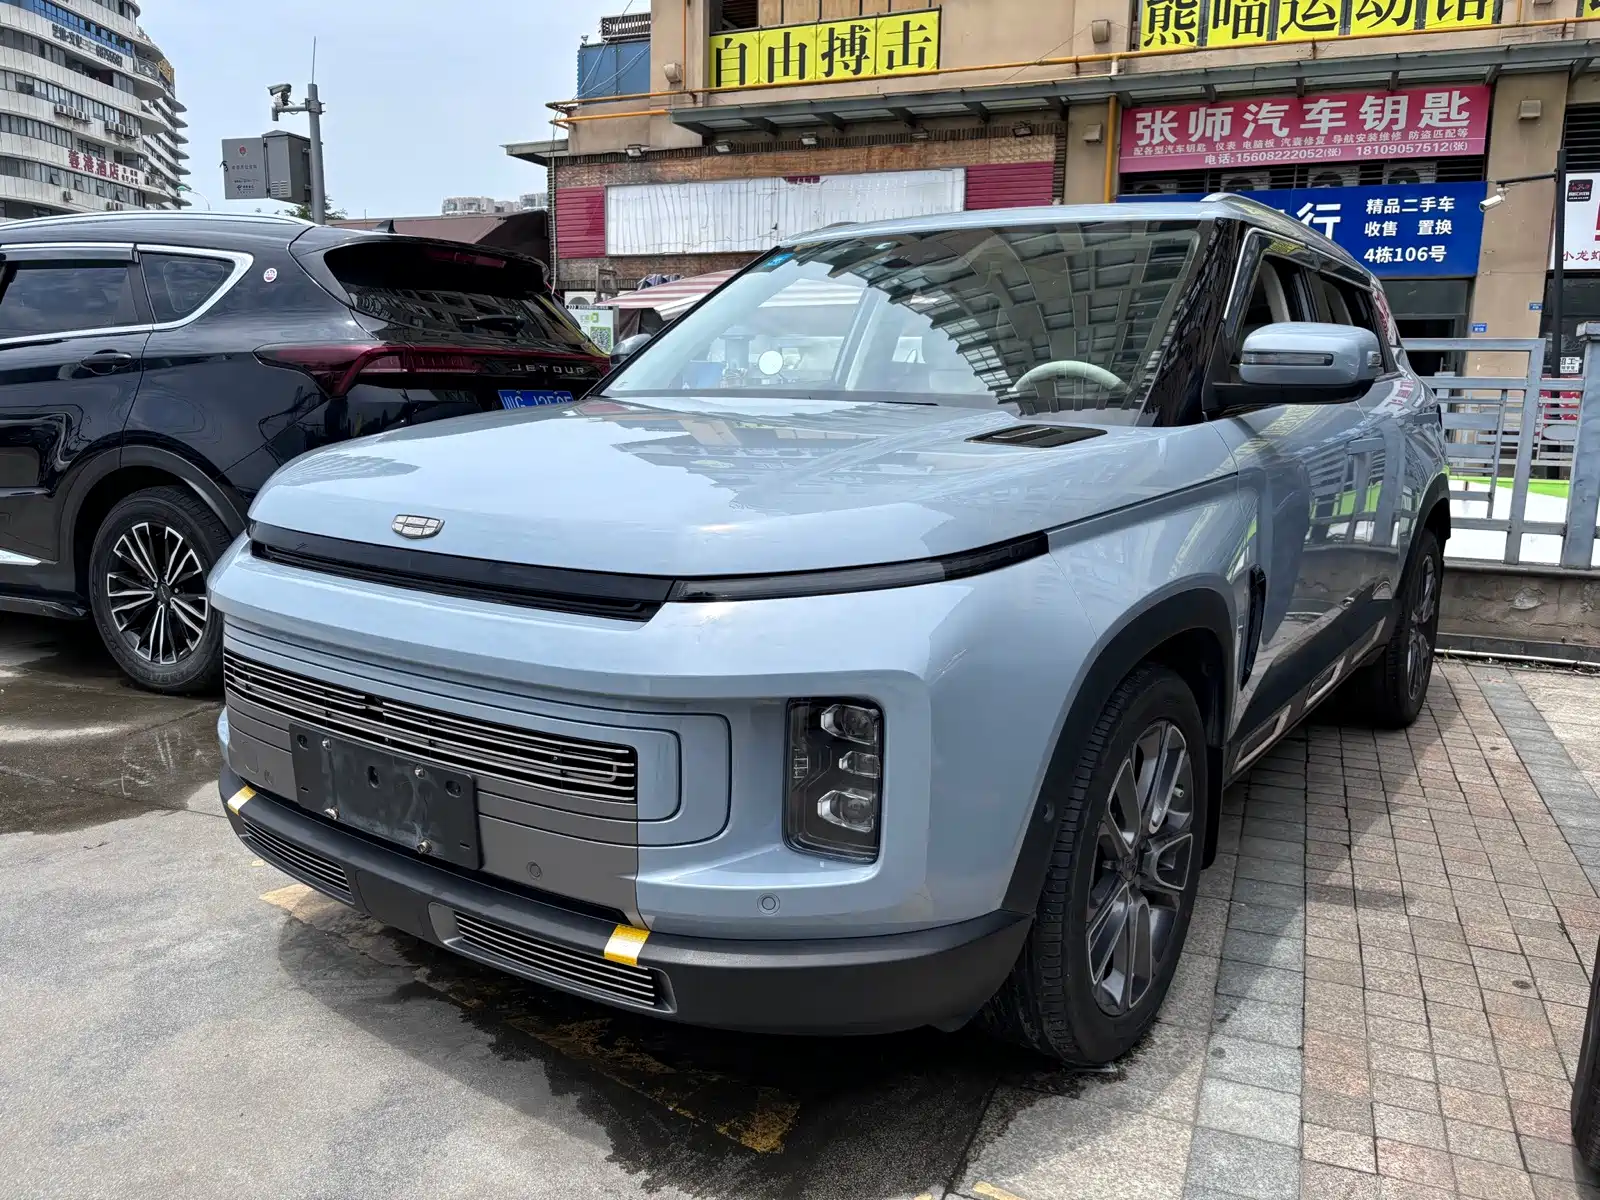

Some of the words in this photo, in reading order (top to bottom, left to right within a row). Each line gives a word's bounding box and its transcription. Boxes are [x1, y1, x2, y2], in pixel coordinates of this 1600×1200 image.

[715, 20, 932, 87] 自由搏击
[1135, 90, 1471, 146] 张师汽车钥匙
[1133, 144, 1206, 156] 配各型汽车钥匙
[1215, 141, 1236, 151] 仪表
[1242, 139, 1275, 150] 电脑板
[1332, 131, 1402, 144] 导航安装维修
[1408, 128, 1469, 141] 防盗匹配等
[1366, 196, 1455, 215] 精品二手车
[1364, 221, 1398, 237] 收售
[1417, 219, 1453, 236] 置换
[1364, 245, 1447, 263] 4栋106号
[512, 364, 586, 375] JETOUR
